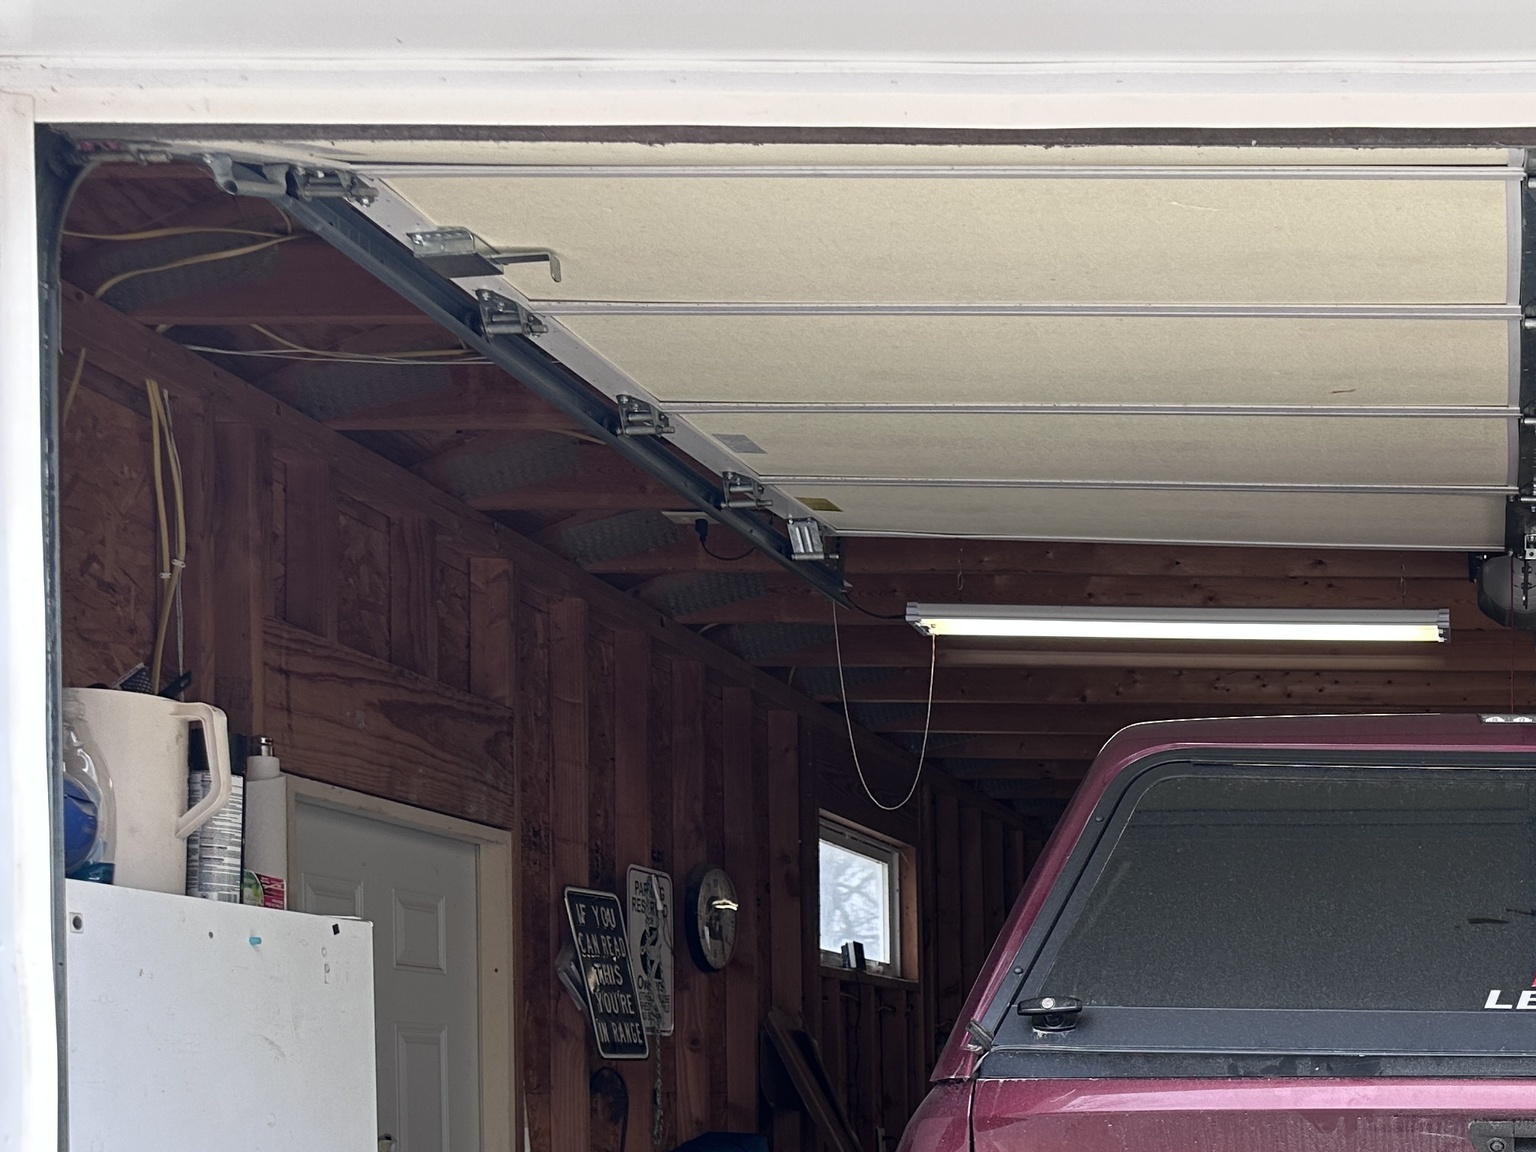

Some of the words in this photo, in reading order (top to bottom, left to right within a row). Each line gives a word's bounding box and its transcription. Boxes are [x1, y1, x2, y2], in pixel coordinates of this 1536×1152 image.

[634, 880, 665, 901] PARG
[575, 903, 587, 926] IF
[592, 905, 617, 929] YOU
[577, 932, 599, 956] CAN
[601, 934, 627, 957] READ
[593, 963, 624, 986] THIS
[595, 990, 636, 1015] YOU'RE
[599, 1020, 611, 1043] IN
[613, 1022, 644, 1045] RANGE
